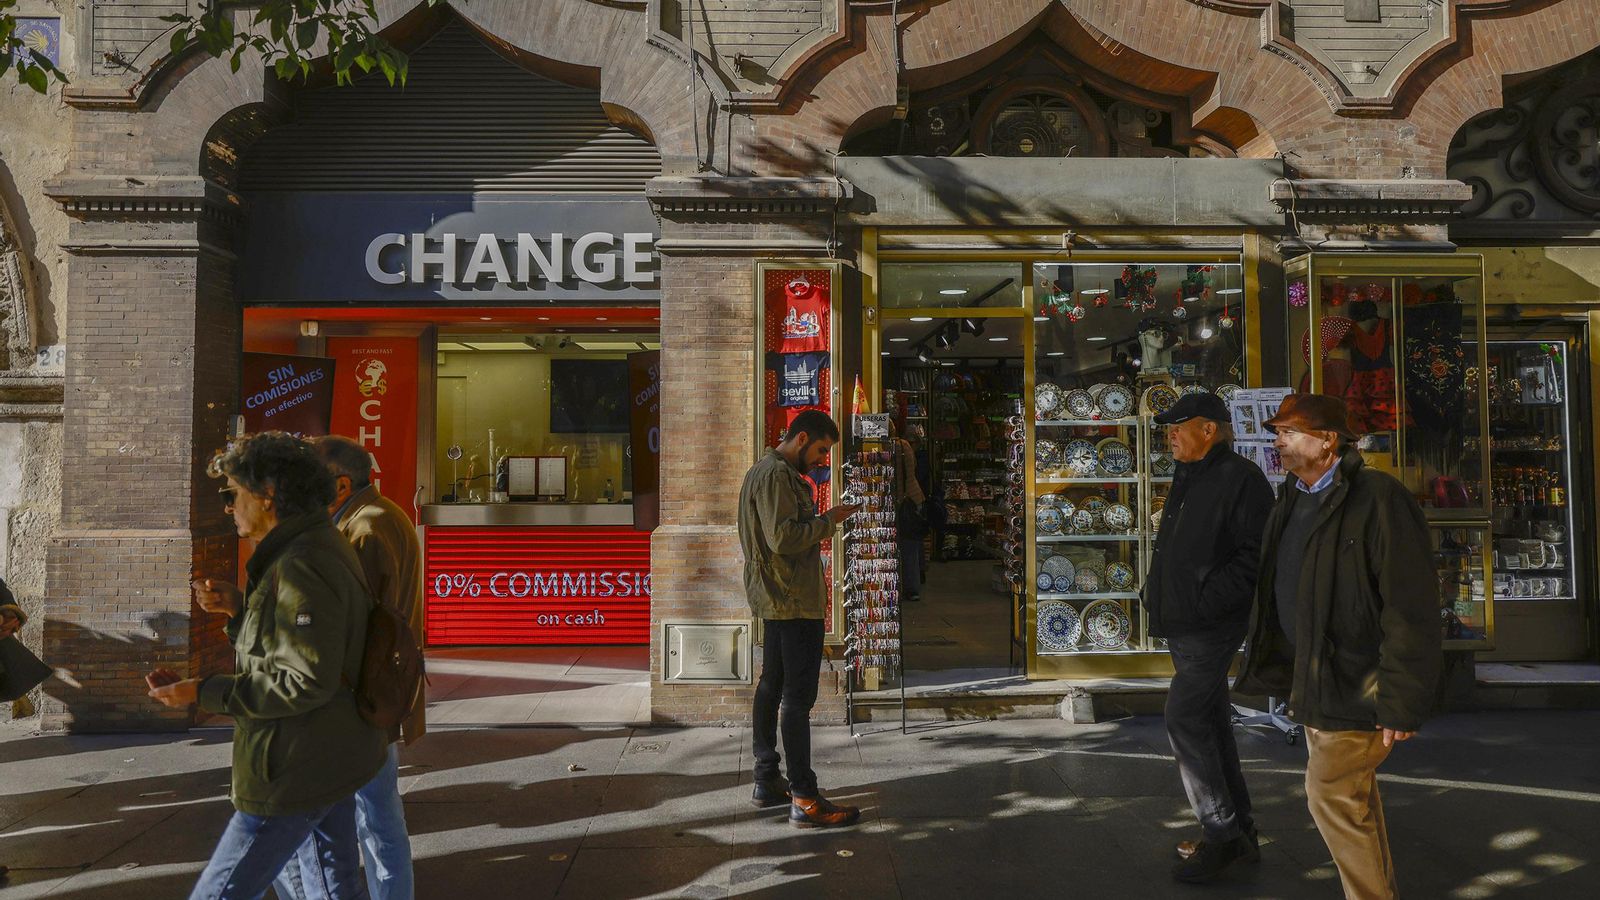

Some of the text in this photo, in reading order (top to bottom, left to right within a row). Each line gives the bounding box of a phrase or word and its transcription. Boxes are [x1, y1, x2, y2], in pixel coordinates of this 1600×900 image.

[364, 231, 655, 285] CHANGE
[40, 349, 65, 366] 28
[267, 363, 295, 385] SIN
[246, 368, 324, 409] COMISIONES
[782, 385, 816, 396] sevilla
[264, 391, 313, 417] en efectivo
[434, 573, 482, 597] 0%
[537, 609, 605, 625] on cash
